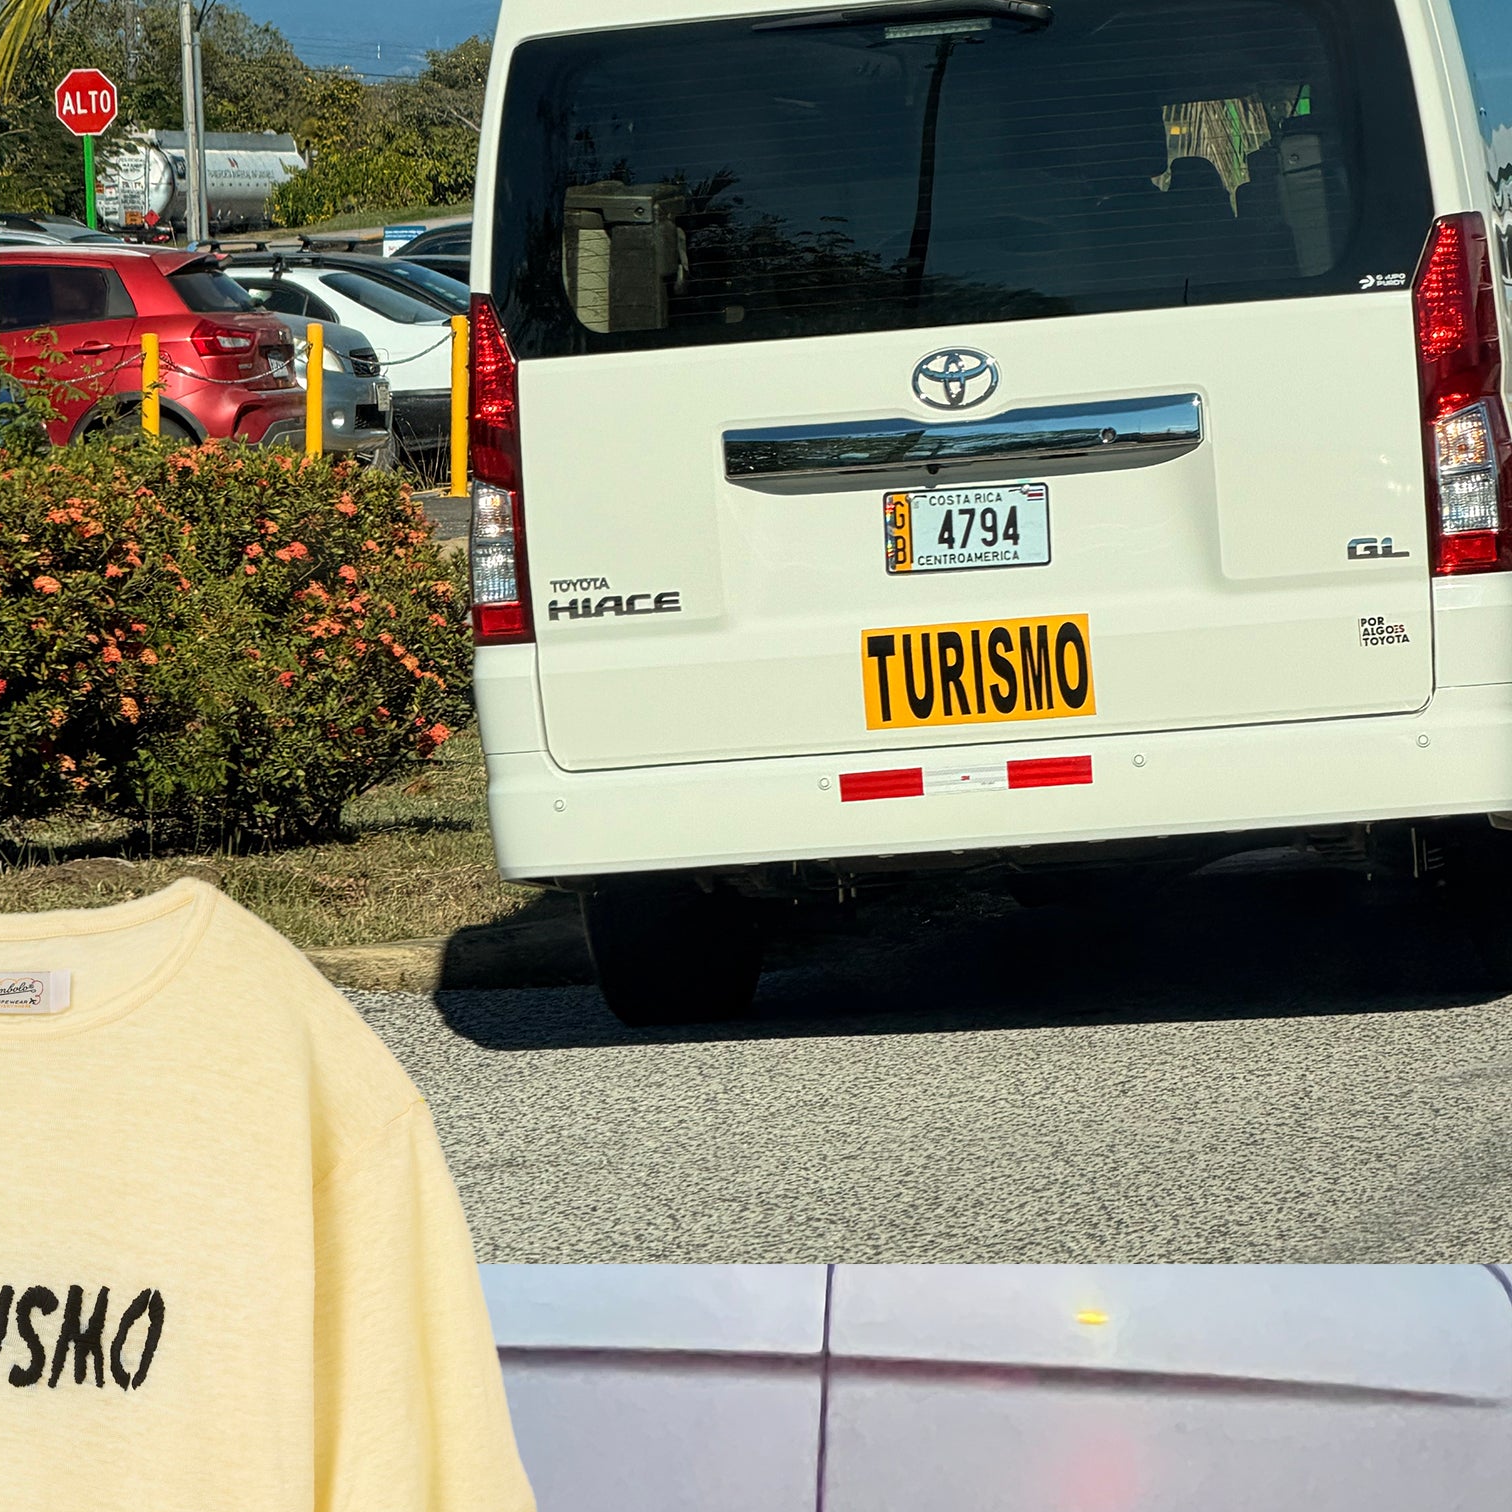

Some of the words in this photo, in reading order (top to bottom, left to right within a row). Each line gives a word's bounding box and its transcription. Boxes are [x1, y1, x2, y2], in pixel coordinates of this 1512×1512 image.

[62, 89, 111, 115] ALTO
[929, 494, 970, 506] COSTA
[975, 492, 1003, 504] RICA
[938, 505, 1020, 550] 4794
[1347, 537, 1410, 559] GL
[918, 550, 1020, 566] CENTROAMERICA
[549, 577, 610, 593] TOYOTA
[548, 591, 682, 621] HIACE
[1361, 617, 1385, 627] POR
[1362, 634, 1410, 647] TOYOTA
[867, 621, 1089, 722] TURISMO
